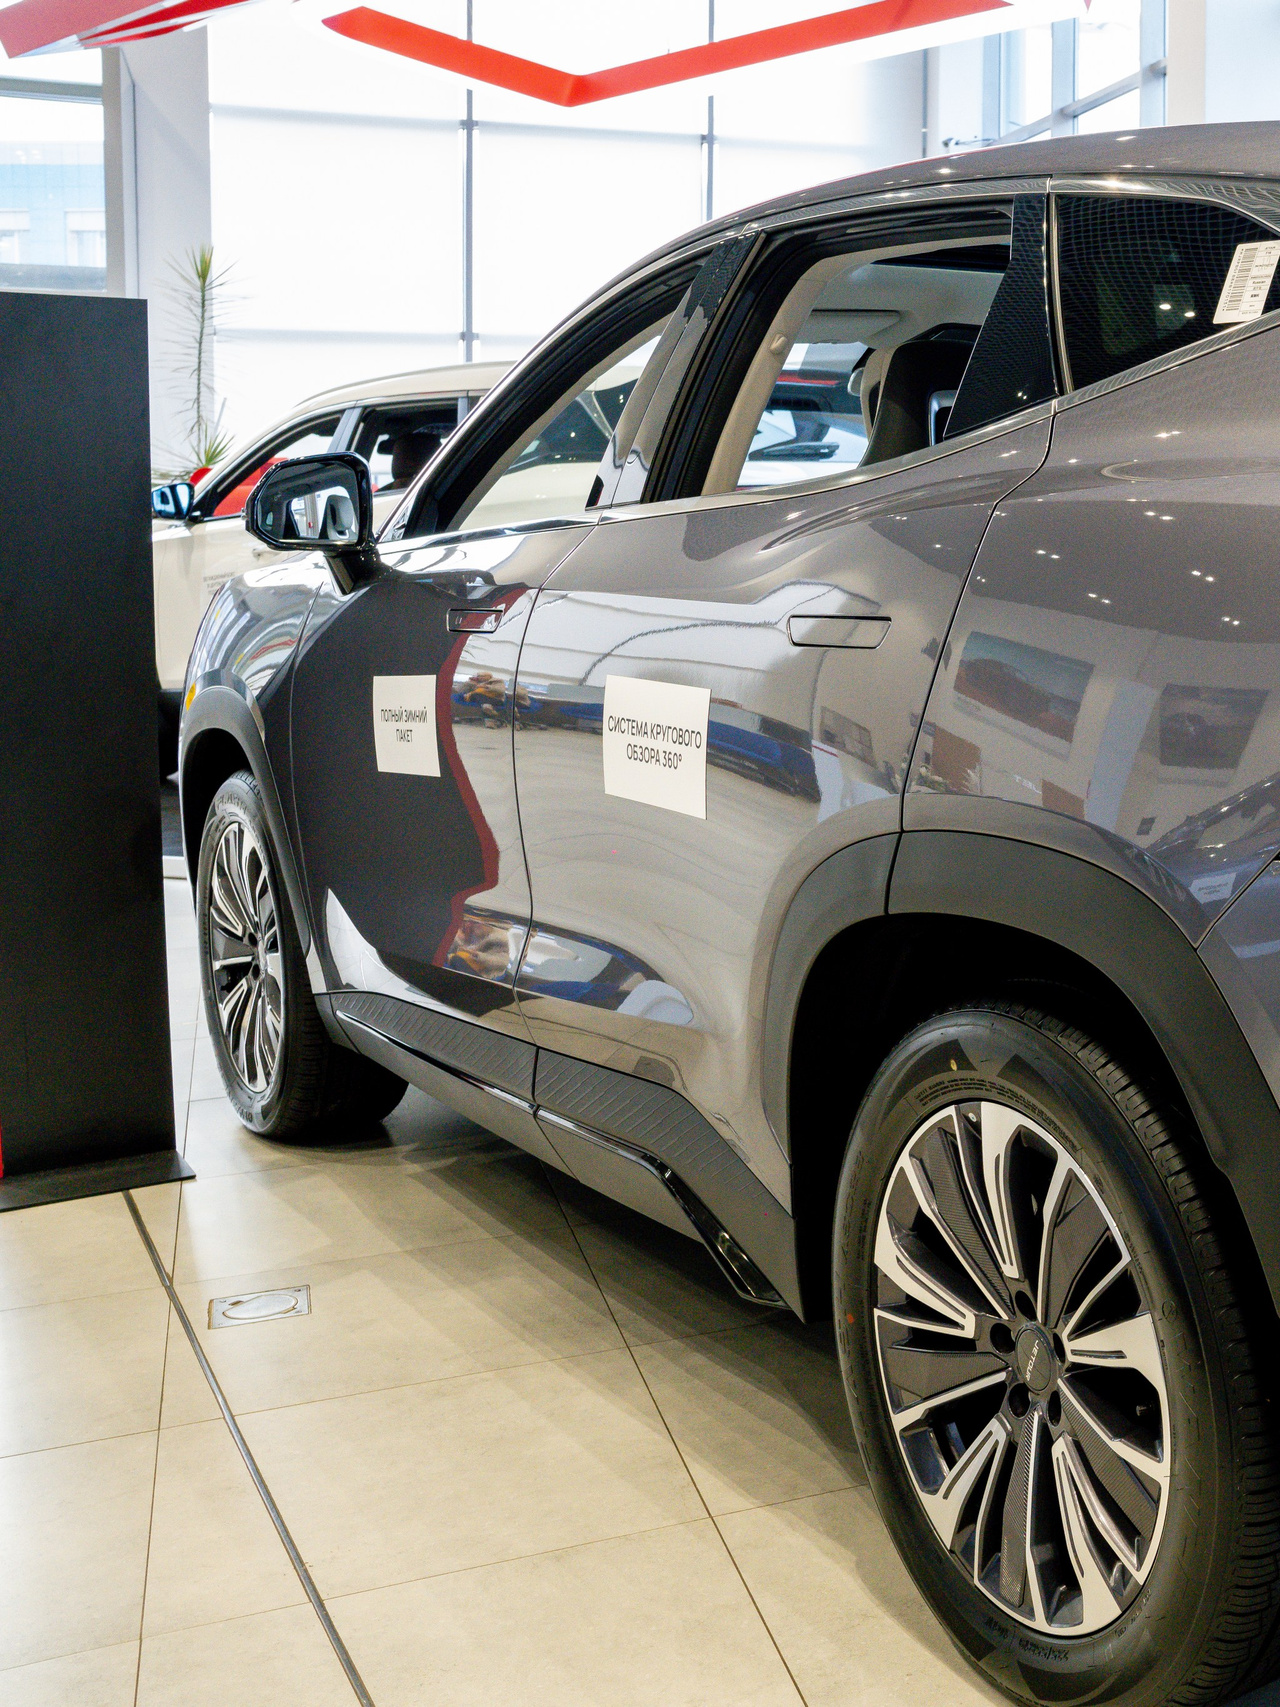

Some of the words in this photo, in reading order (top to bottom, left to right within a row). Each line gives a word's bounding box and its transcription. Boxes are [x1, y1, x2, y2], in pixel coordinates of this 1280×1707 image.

[380, 706, 404, 722] ПОЛНЫЙ
[404, 706, 428, 723] ЗИМНИЙ
[395, 728, 413, 743] ПАКЕТ
[607, 715, 649, 738] СИСТЕМА
[650, 723, 703, 749] КРУГОВОГО
[626, 743, 661, 766] ОБЗОРА
[1025, 1339, 1040, 1382] JETOUR
